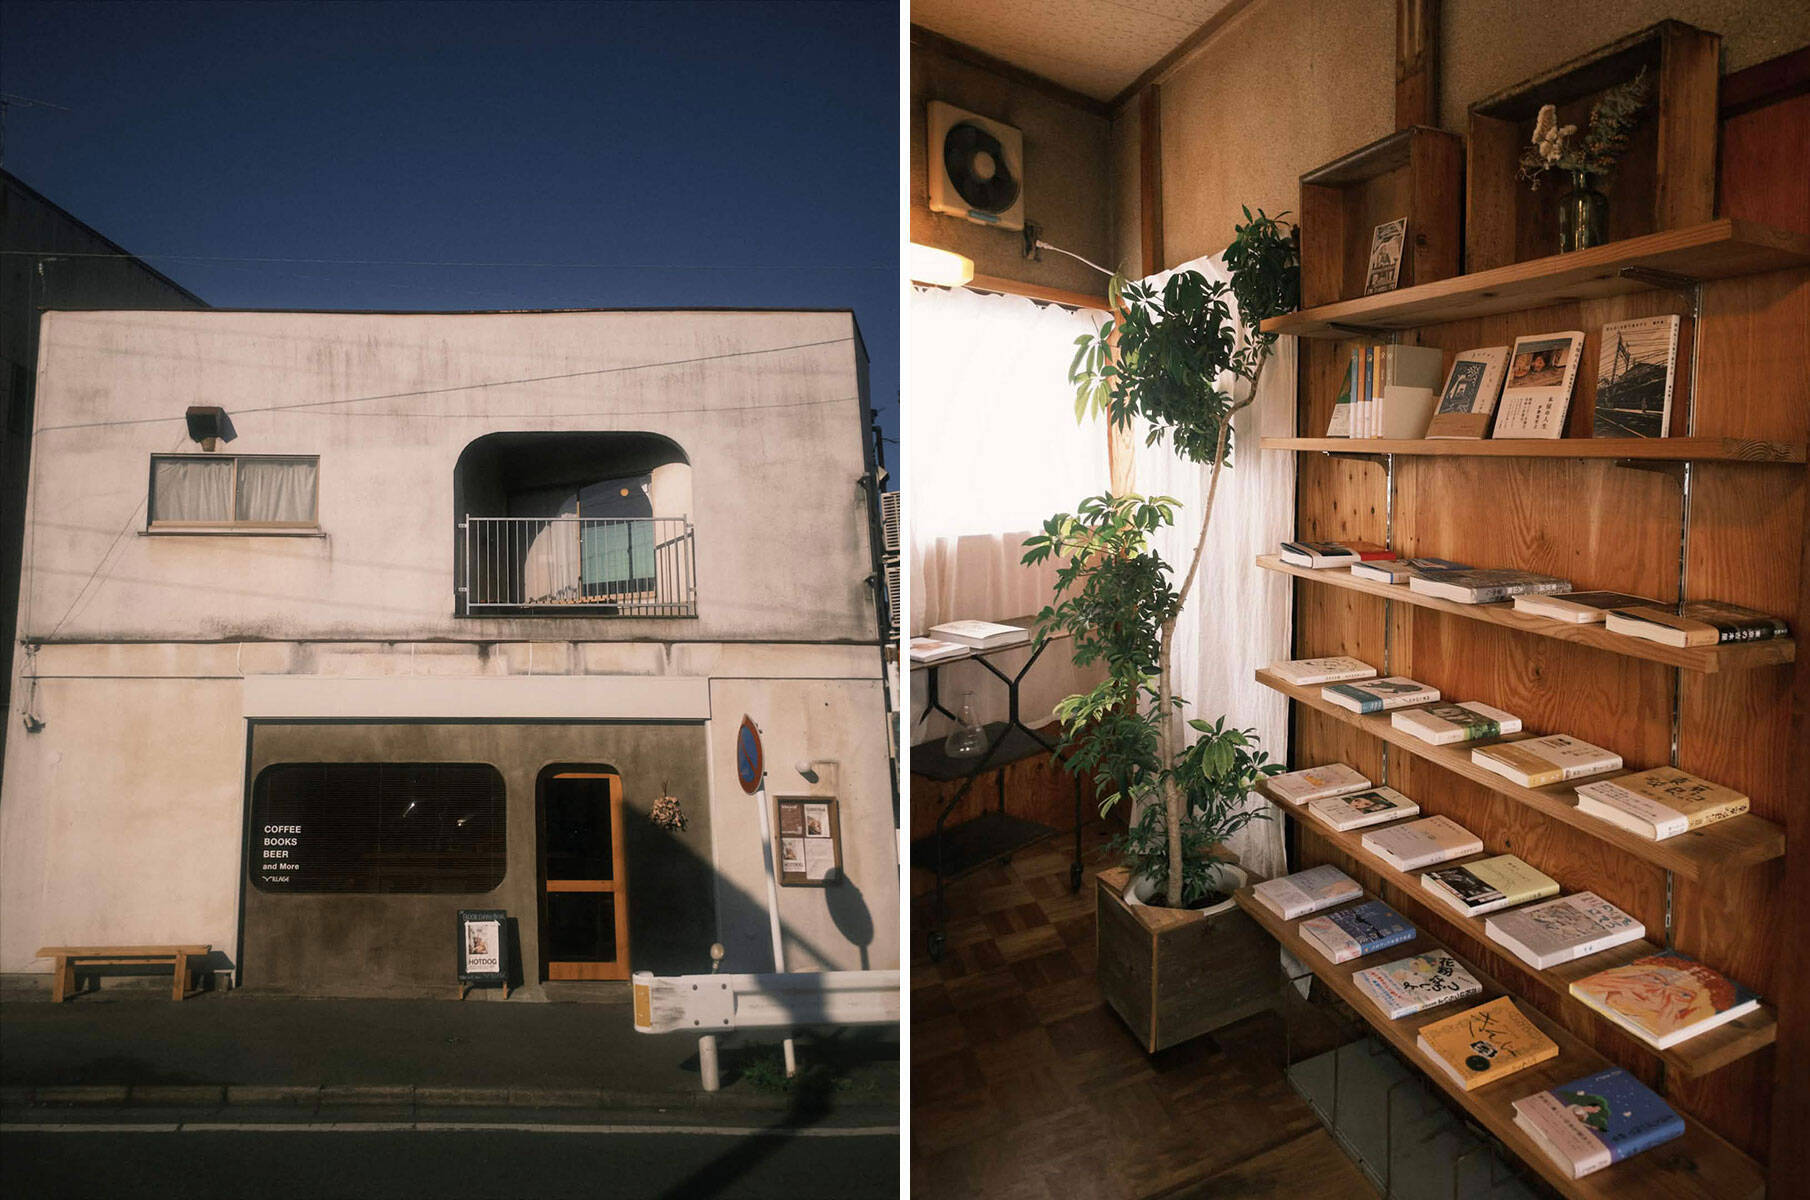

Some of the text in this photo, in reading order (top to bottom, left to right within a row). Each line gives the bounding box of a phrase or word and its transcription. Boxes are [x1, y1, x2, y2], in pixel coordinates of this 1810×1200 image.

[264, 825, 301, 834] COFFEE
[263, 837, 298, 846] BOOKS
[263, 850, 289, 858] BEER
[468, 958, 498, 966] HOTDOG
